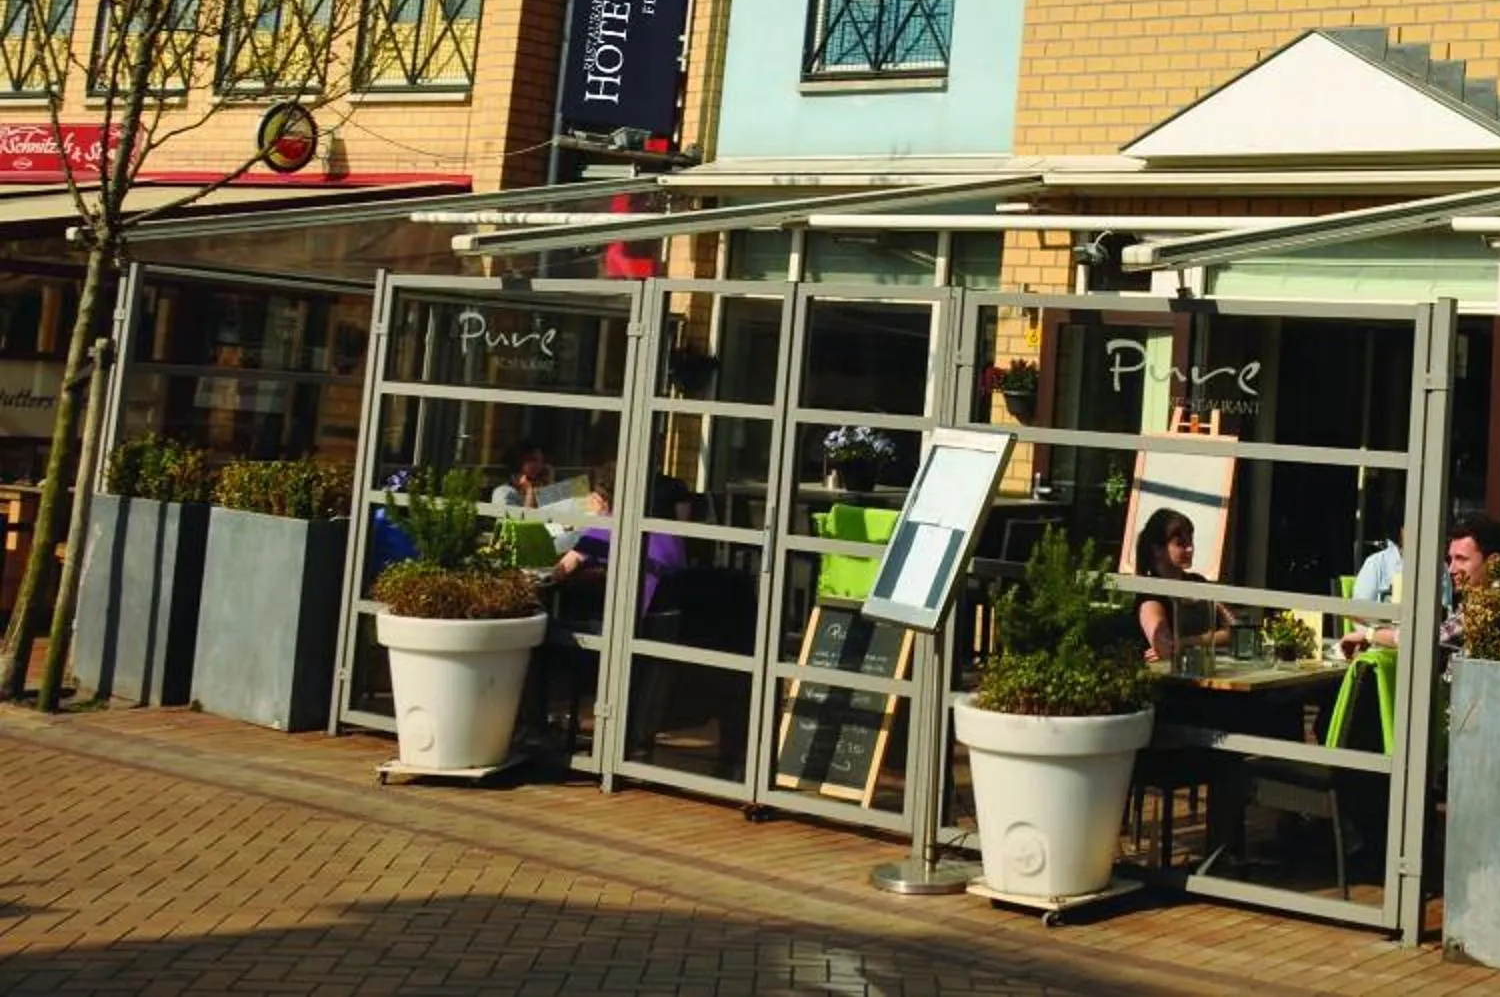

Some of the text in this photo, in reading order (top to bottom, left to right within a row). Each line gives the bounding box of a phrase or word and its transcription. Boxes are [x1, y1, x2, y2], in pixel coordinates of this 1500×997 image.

[4, 132, 75, 154] Schnitzls
[459, 311, 557, 356] Pure
[1106, 338, 1261, 396] Pure
